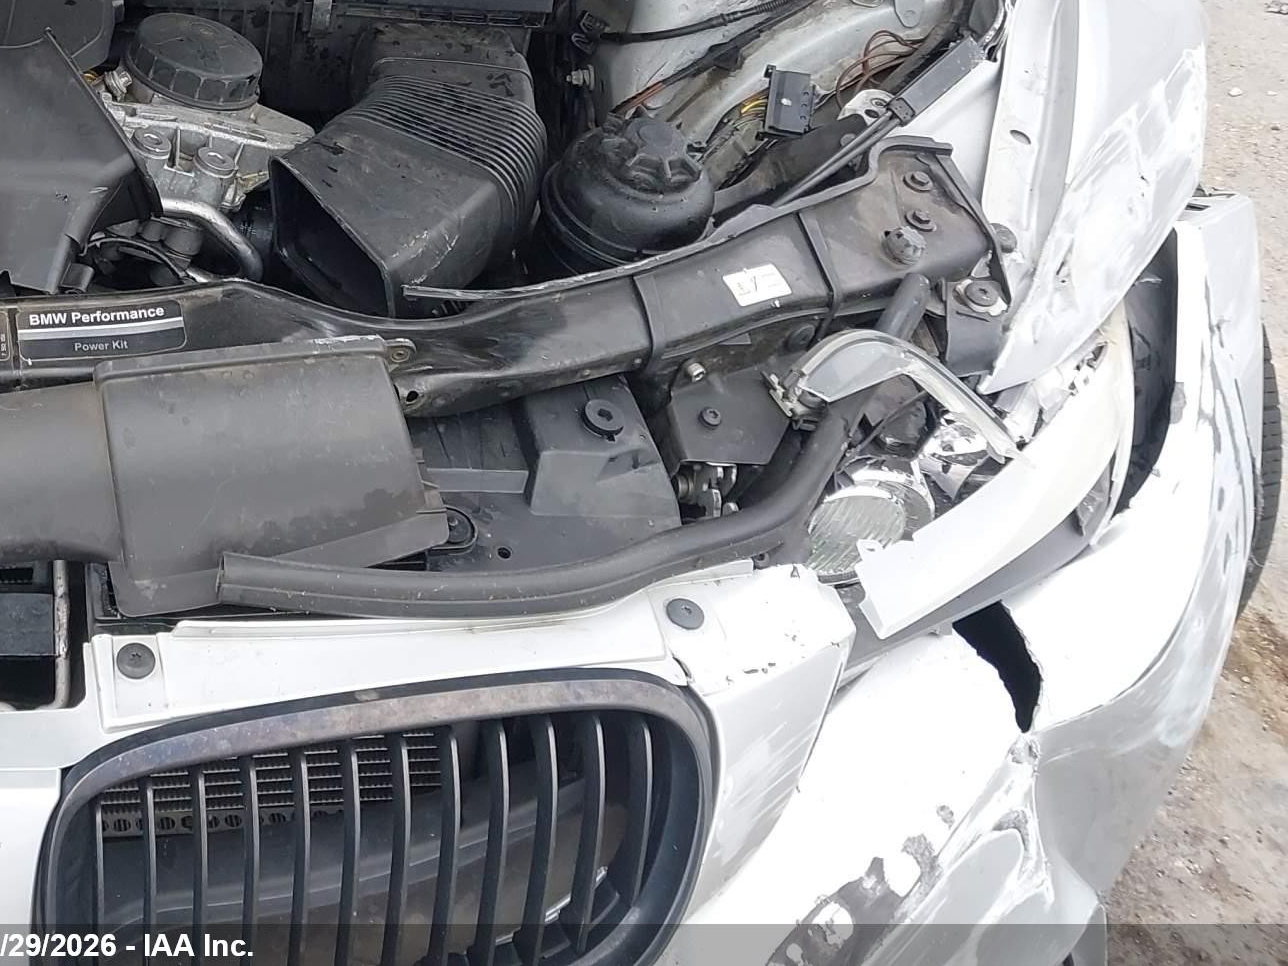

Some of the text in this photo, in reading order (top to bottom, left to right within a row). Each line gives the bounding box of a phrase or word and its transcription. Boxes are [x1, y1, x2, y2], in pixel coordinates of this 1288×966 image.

[29, 306, 165, 325] BMW Performance
[74, 340, 128, 351] Power Kit
